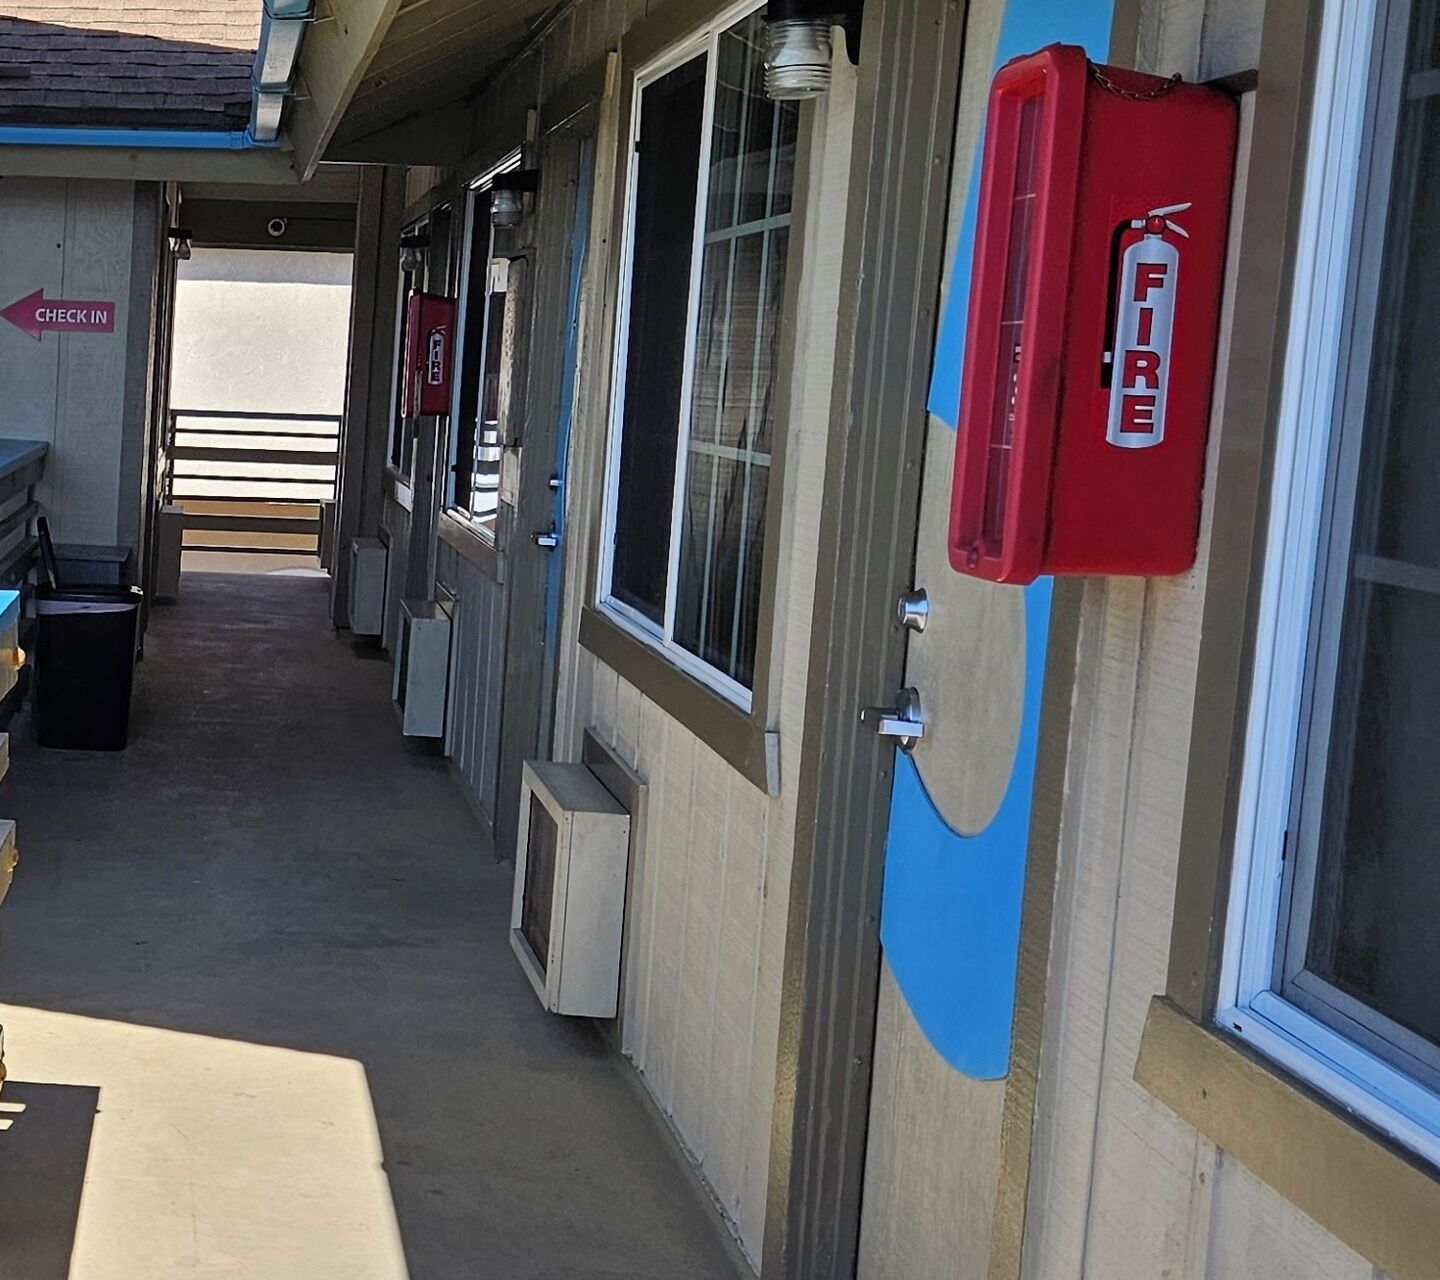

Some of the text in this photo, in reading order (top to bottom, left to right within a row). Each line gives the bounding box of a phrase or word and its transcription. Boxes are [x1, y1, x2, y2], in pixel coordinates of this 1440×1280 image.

[35, 308, 108, 324] CHECK IN
[430, 339, 442, 382] FIRE
[1120, 262, 1168, 434] FIRE
